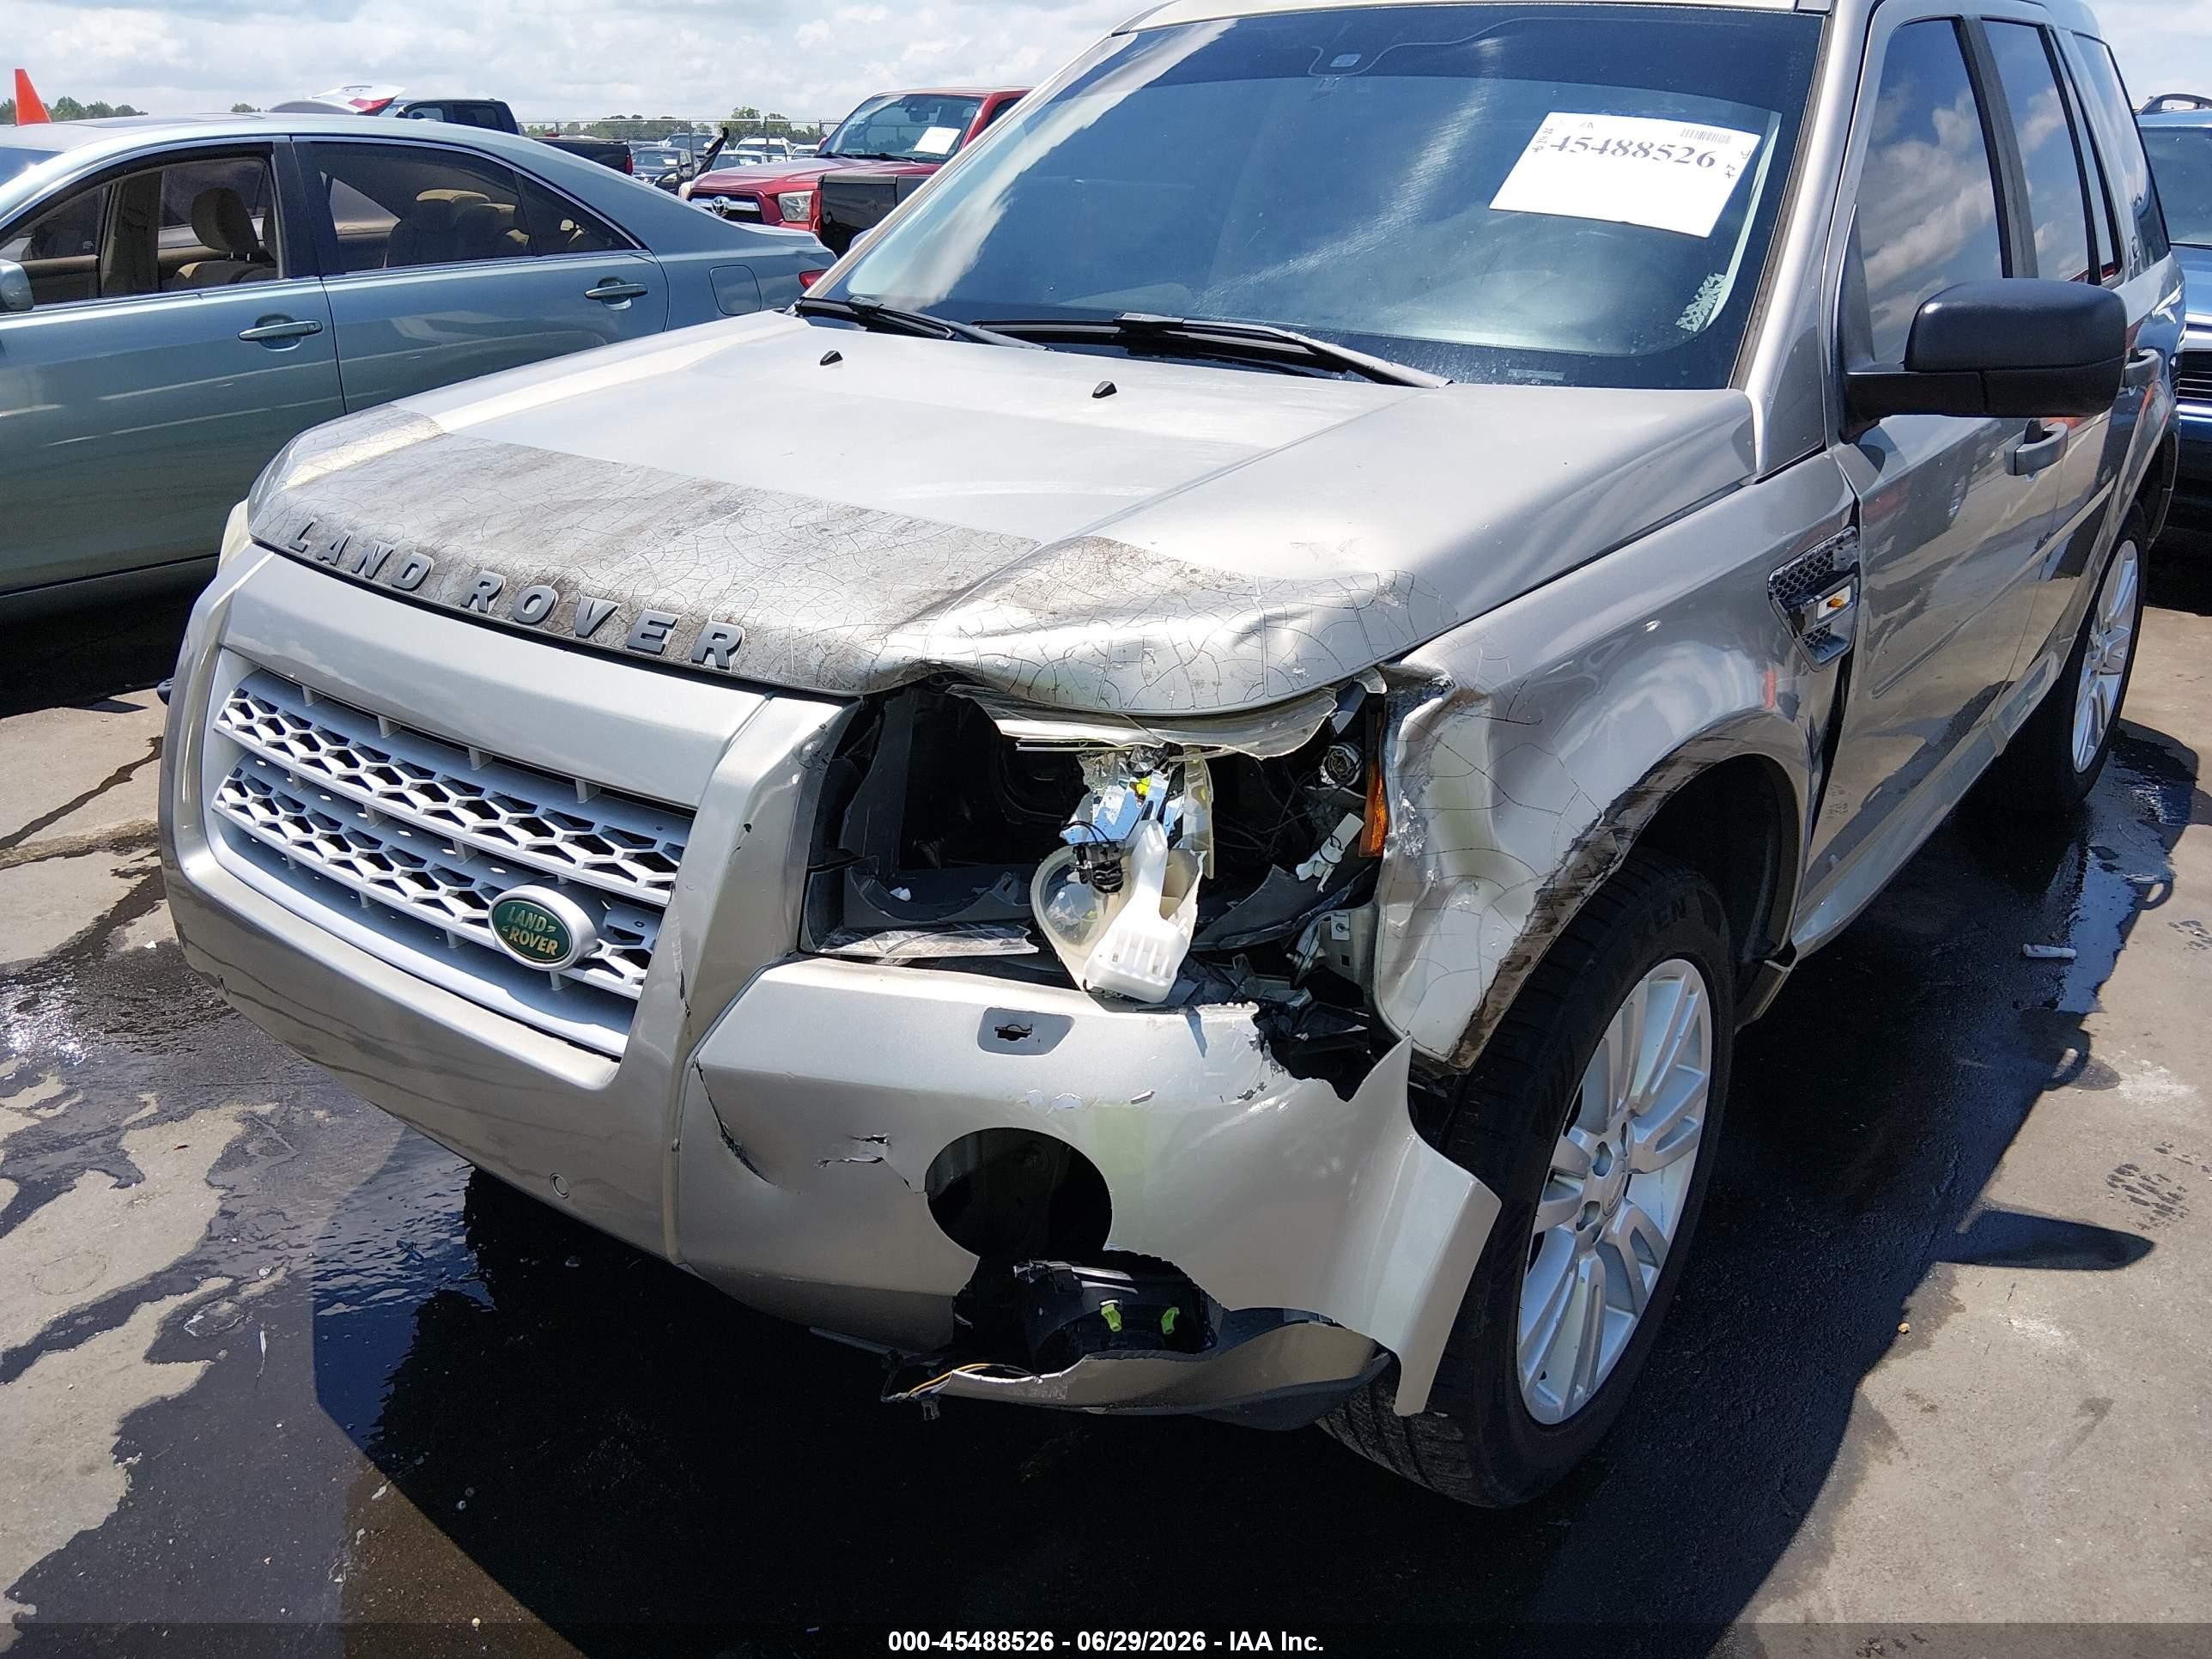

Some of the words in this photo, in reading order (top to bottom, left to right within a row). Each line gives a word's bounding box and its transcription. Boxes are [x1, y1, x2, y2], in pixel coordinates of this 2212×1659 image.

[1549, 135, 1717, 168] 45488526
[289, 518, 434, 592] LAND
[460, 569, 746, 671] ROVER
[507, 906, 548, 933] LAND
[508, 927, 558, 956] ROVER
